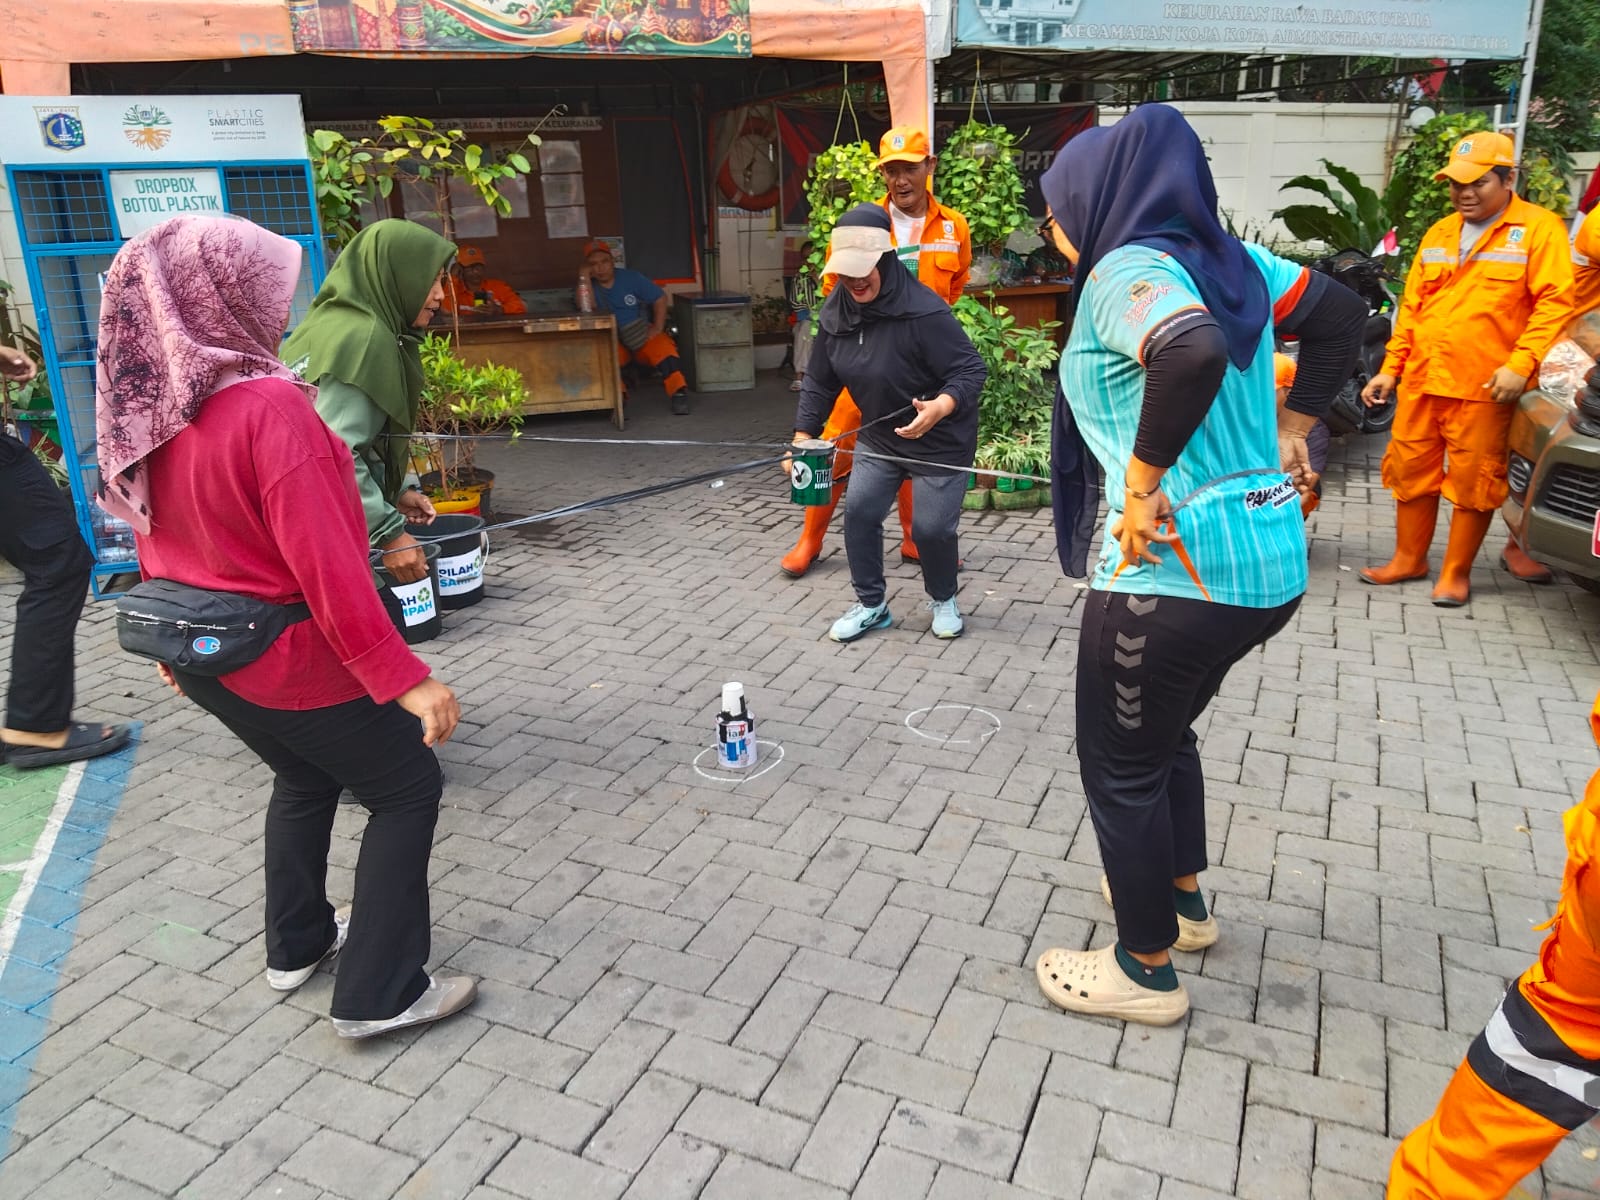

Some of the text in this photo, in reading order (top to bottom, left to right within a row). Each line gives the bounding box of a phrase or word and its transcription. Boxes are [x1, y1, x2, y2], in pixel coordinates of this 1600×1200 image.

[1164, 4, 1432, 28] KELURAHAN RAWA BADAK UTARA
[1061, 23, 1510, 49] KECAMATAN KOJA KOTA ADMINISTRASI JAKARTA UTARA
[208, 109, 264, 118] PLASTIC
[209, 118, 265, 126] SMARTCITIES
[136, 177, 197, 194] DROPBOX
[122, 195, 220, 213] BOTOL PLASTIK
[438, 563, 474, 577] PILAH
